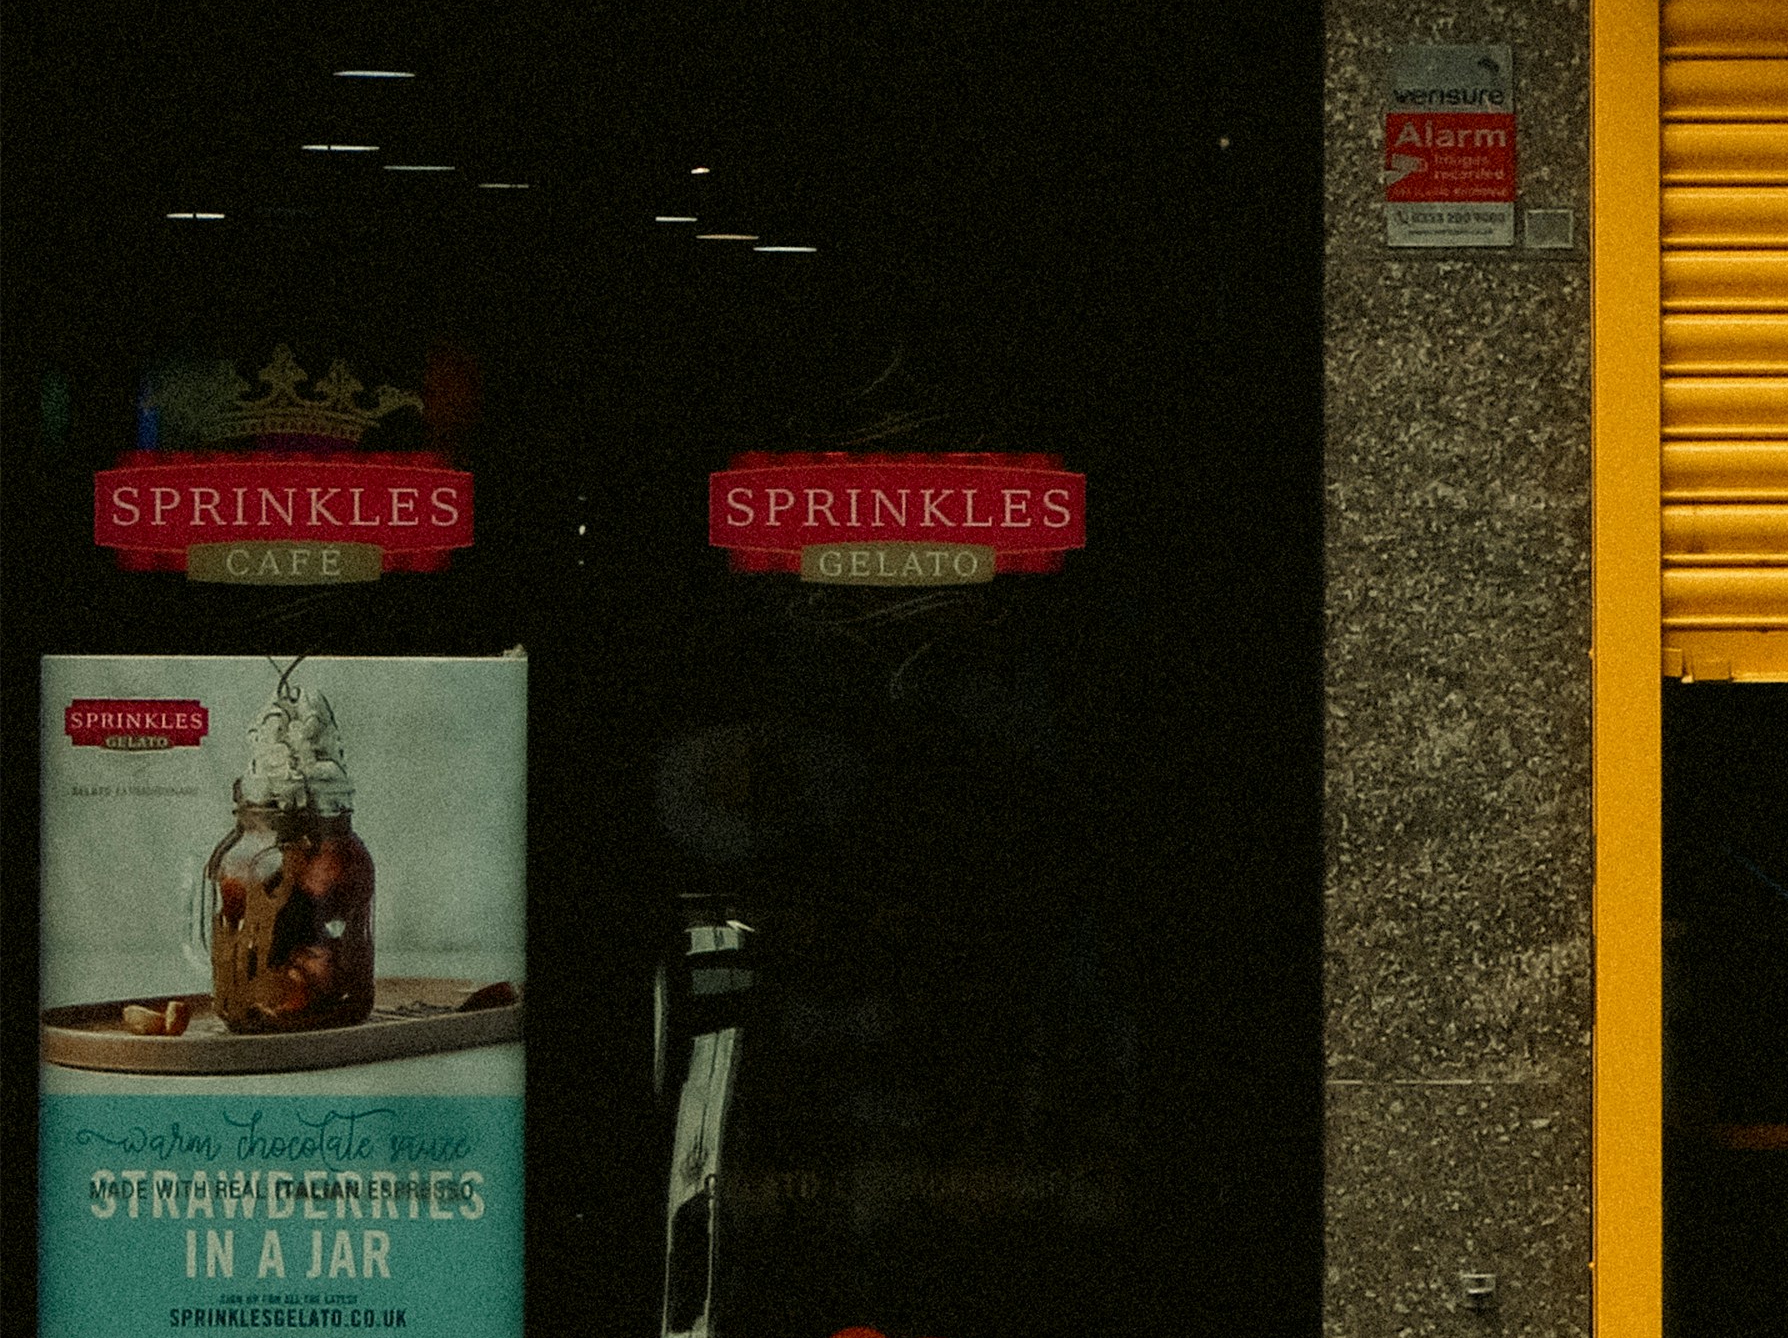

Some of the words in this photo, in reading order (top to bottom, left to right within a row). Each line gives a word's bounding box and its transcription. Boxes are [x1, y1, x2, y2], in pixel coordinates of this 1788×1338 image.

[1394, 120, 1507, 148] Alarm
[110, 486, 461, 529] SPRINKLES
[725, 488, 1073, 530] SPRINKLES
[818, 549, 980, 580] GELATO
[70, 712, 204, 730] SPRINKLES
[105, 737, 169, 749] GELATO
[76, 1122, 223, 1160] warm
[222, 1109, 399, 1172] chocolate
[89, 1179, 147, 1201] MADE
[155, 1179, 206, 1201] WITH
[274, 1179, 359, 1201] ITALIAN
[89, 1169, 486, 1220] STRAWBERRIES
[184, 1228, 235, 1279] IN
[256, 1228, 286, 1279] A
[305, 1228, 391, 1279] JAR
[169, 1307, 407, 1329] SPRINKLESGELATO.CO.UK
